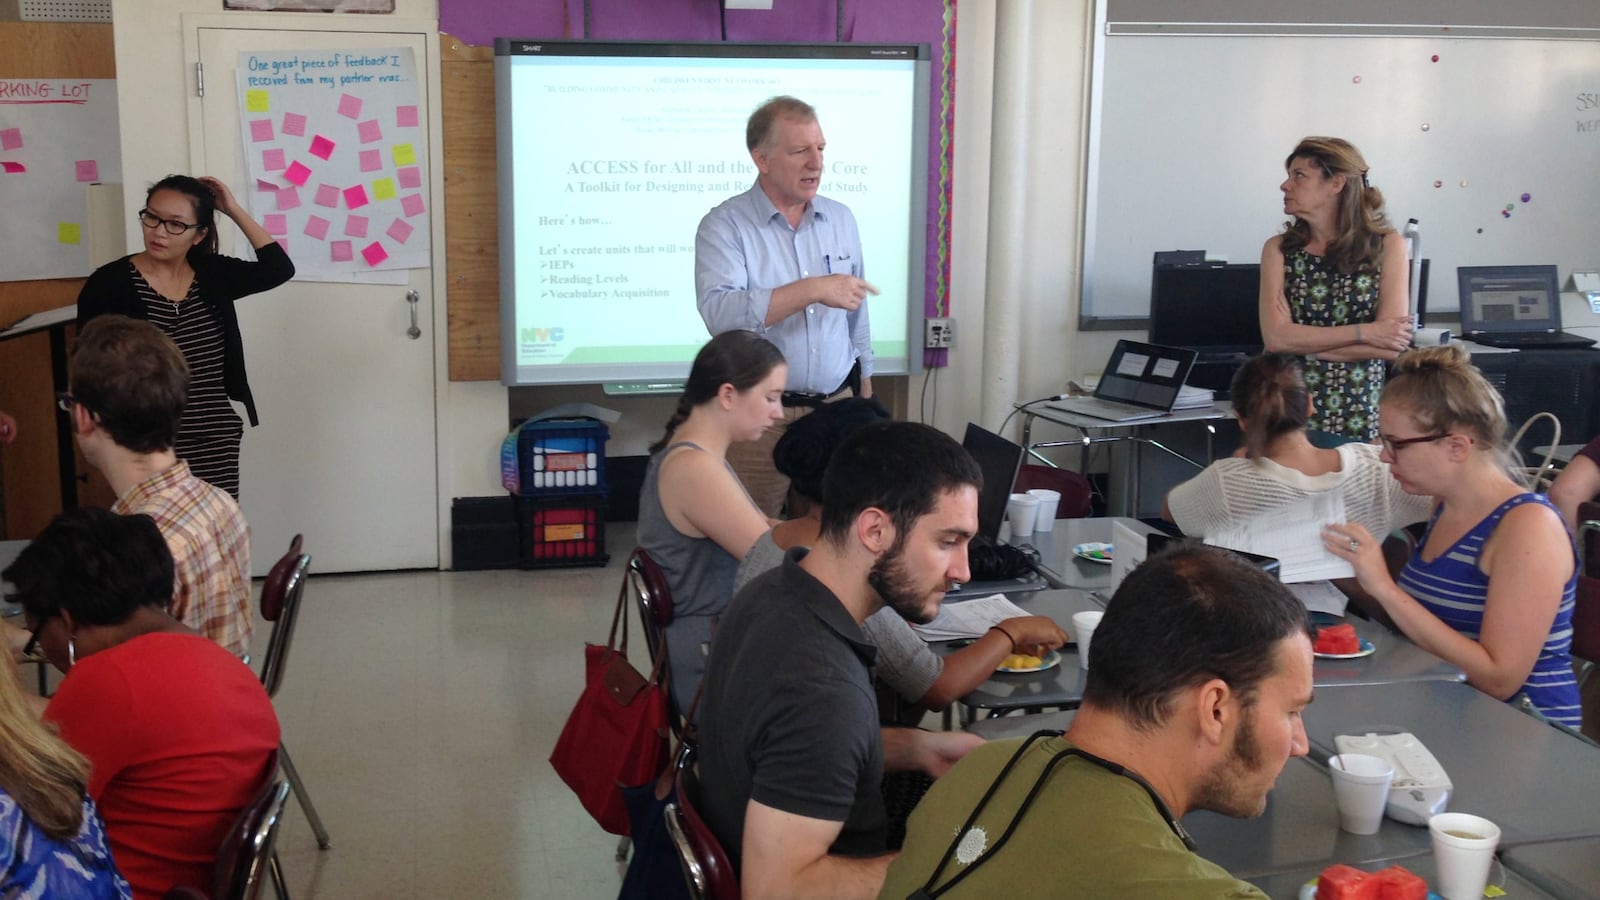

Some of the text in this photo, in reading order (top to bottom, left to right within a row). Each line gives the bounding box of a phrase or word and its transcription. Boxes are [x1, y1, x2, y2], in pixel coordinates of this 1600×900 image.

[248, 53, 401, 75] One great piece of feedback I
[248, 75, 287, 87] received
[319, 77, 335, 88] my
[62, 83, 92, 98] LOT
[1576, 92, 1600, 111] SSI
[567, 160, 639, 175] ACCESS
[644, 160, 666, 174] for
[670, 160, 692, 174] All
[697, 160, 725, 174] and
[731, 160, 753, 174] the
[832, 161, 868, 175] Core
[564, 183, 574, 193] A
[578, 182, 620, 193] Toolkit
[624, 181, 642, 193] for
[646, 181, 704, 194] Designing
[707, 180, 729, 192] and
[820, 182, 831, 192] of
[835, 181, 868, 193] Study
[571, 247, 603, 255] create
[606, 246, 631, 254] units
[634, 245, 655, 254] that
[658, 244, 676, 253] will
[549, 260, 575, 270] IEPs
[550, 273, 629, 285] Reading Levels
[550, 288, 670, 300] Vocabulary Acquisition
[521, 327, 564, 342] NYC
